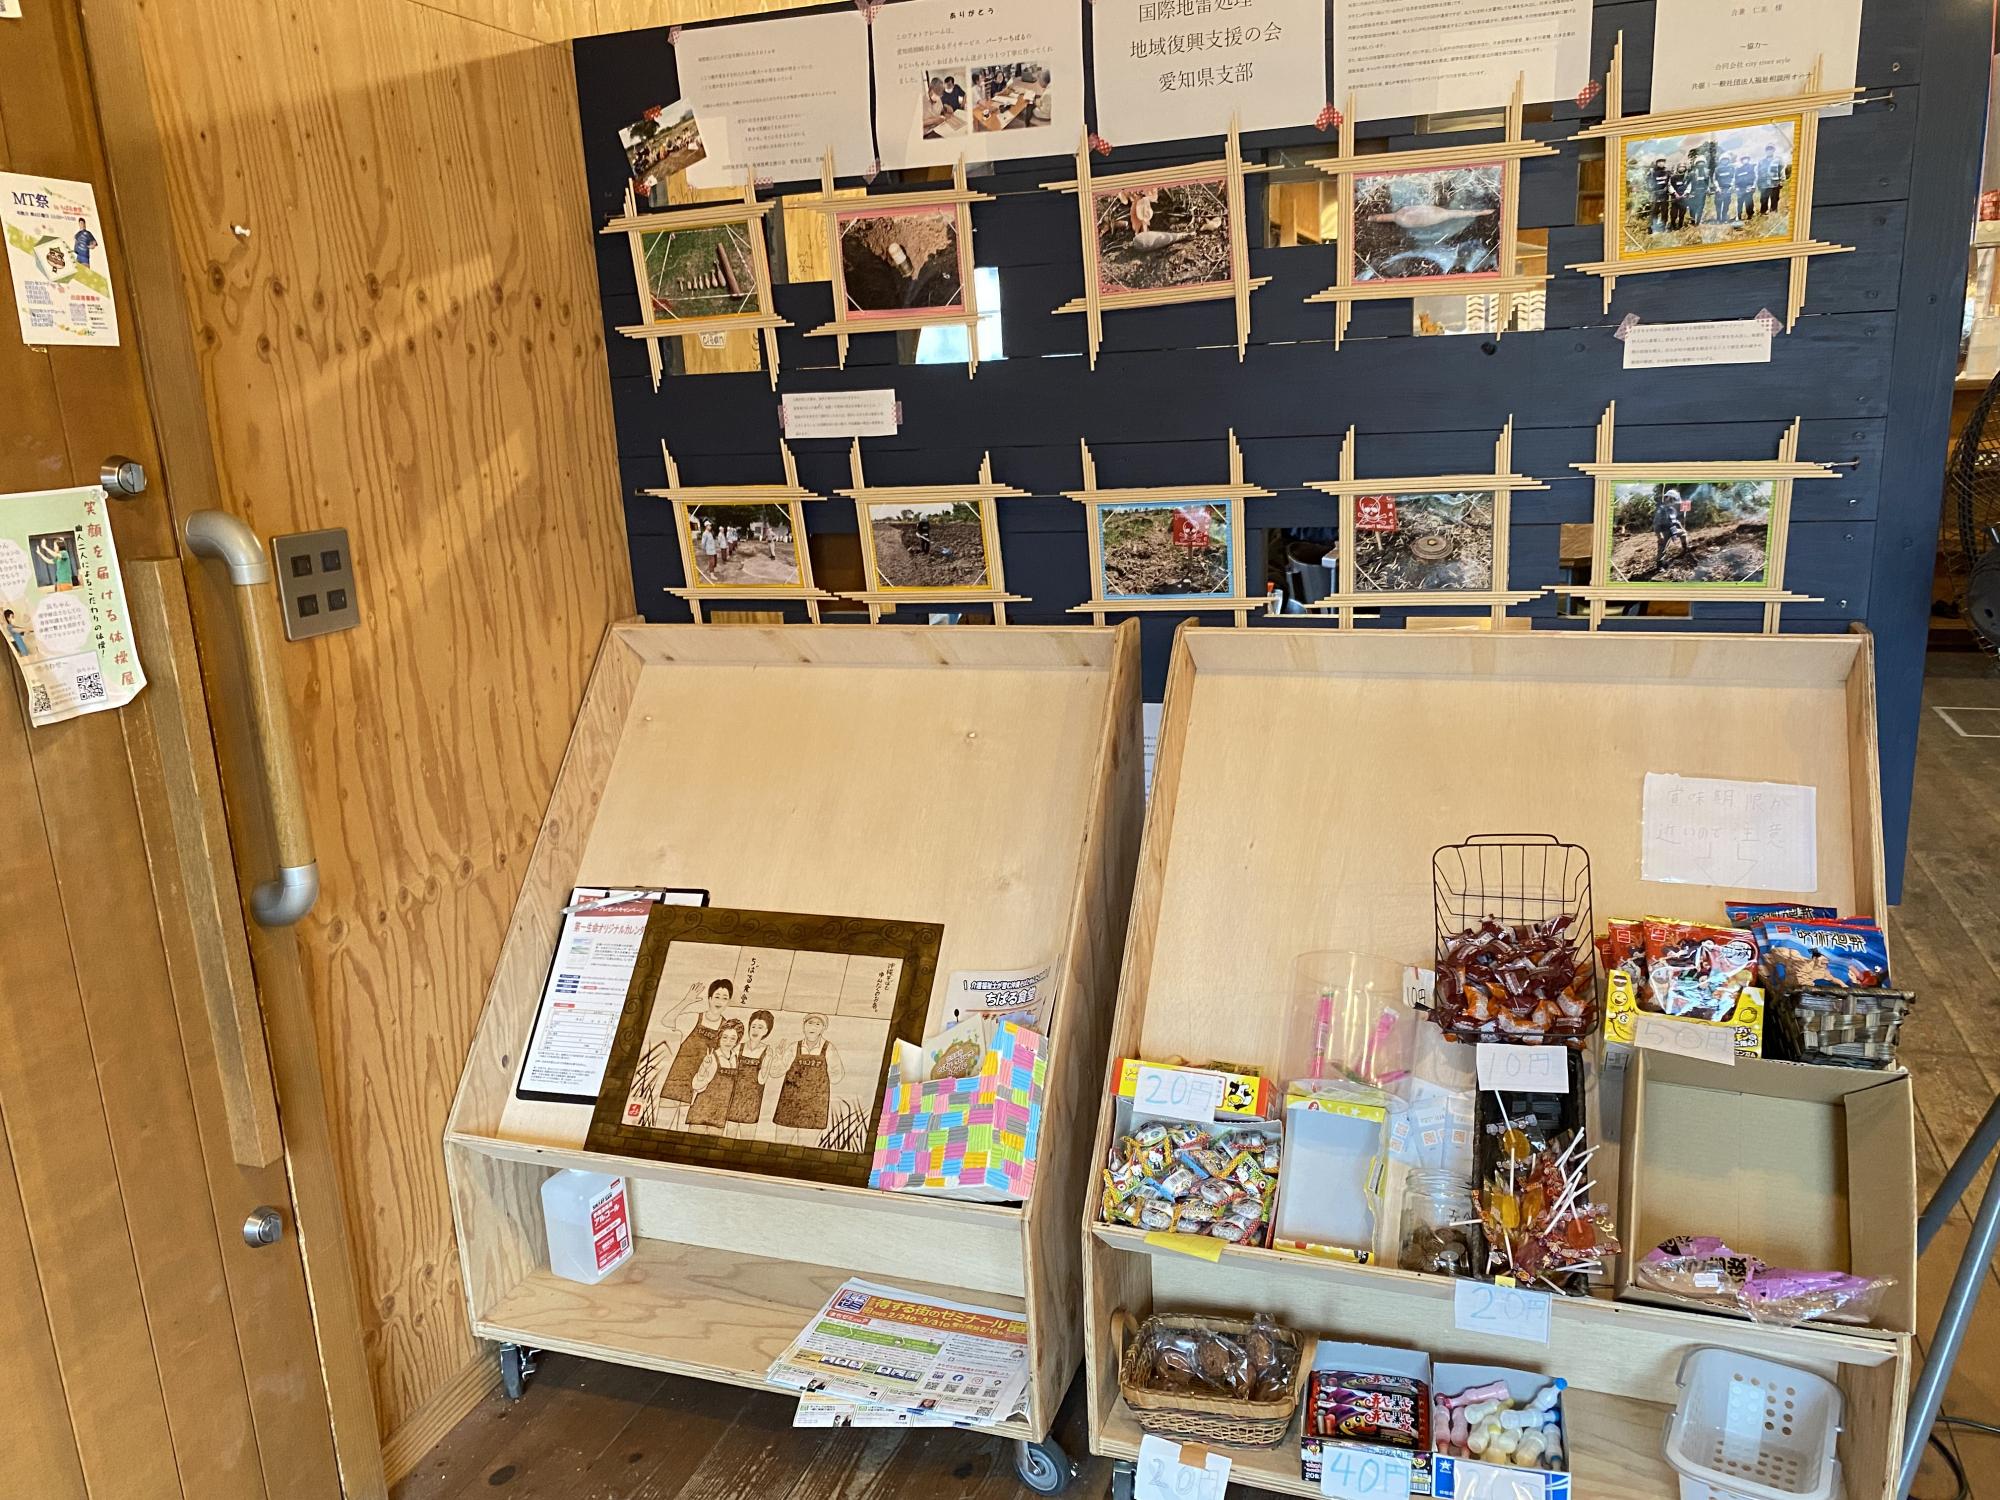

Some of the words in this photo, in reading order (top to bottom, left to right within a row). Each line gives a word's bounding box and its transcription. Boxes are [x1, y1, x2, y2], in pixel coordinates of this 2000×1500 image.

[949, 7, 995, 19] ありがとう
[1129, 21, 1283, 59] 地域復興支援の会
[1158, 62, 1253, 92] 愛知県支部
[11, 191, 50, 209] MT祭
[84, 500, 135, 686] 笑顔を届ける体操屋
[985, 985, 1037, 1007] ちばる食堂
[1488, 1051, 1550, 1080] 10円
[1144, 1074, 1214, 1112] 20円
[873, 1298, 1008, 1330] 得する街のゼミナール
[1470, 1286, 1547, 1320] 20円
[1330, 1452, 1410, 1498] 40円
